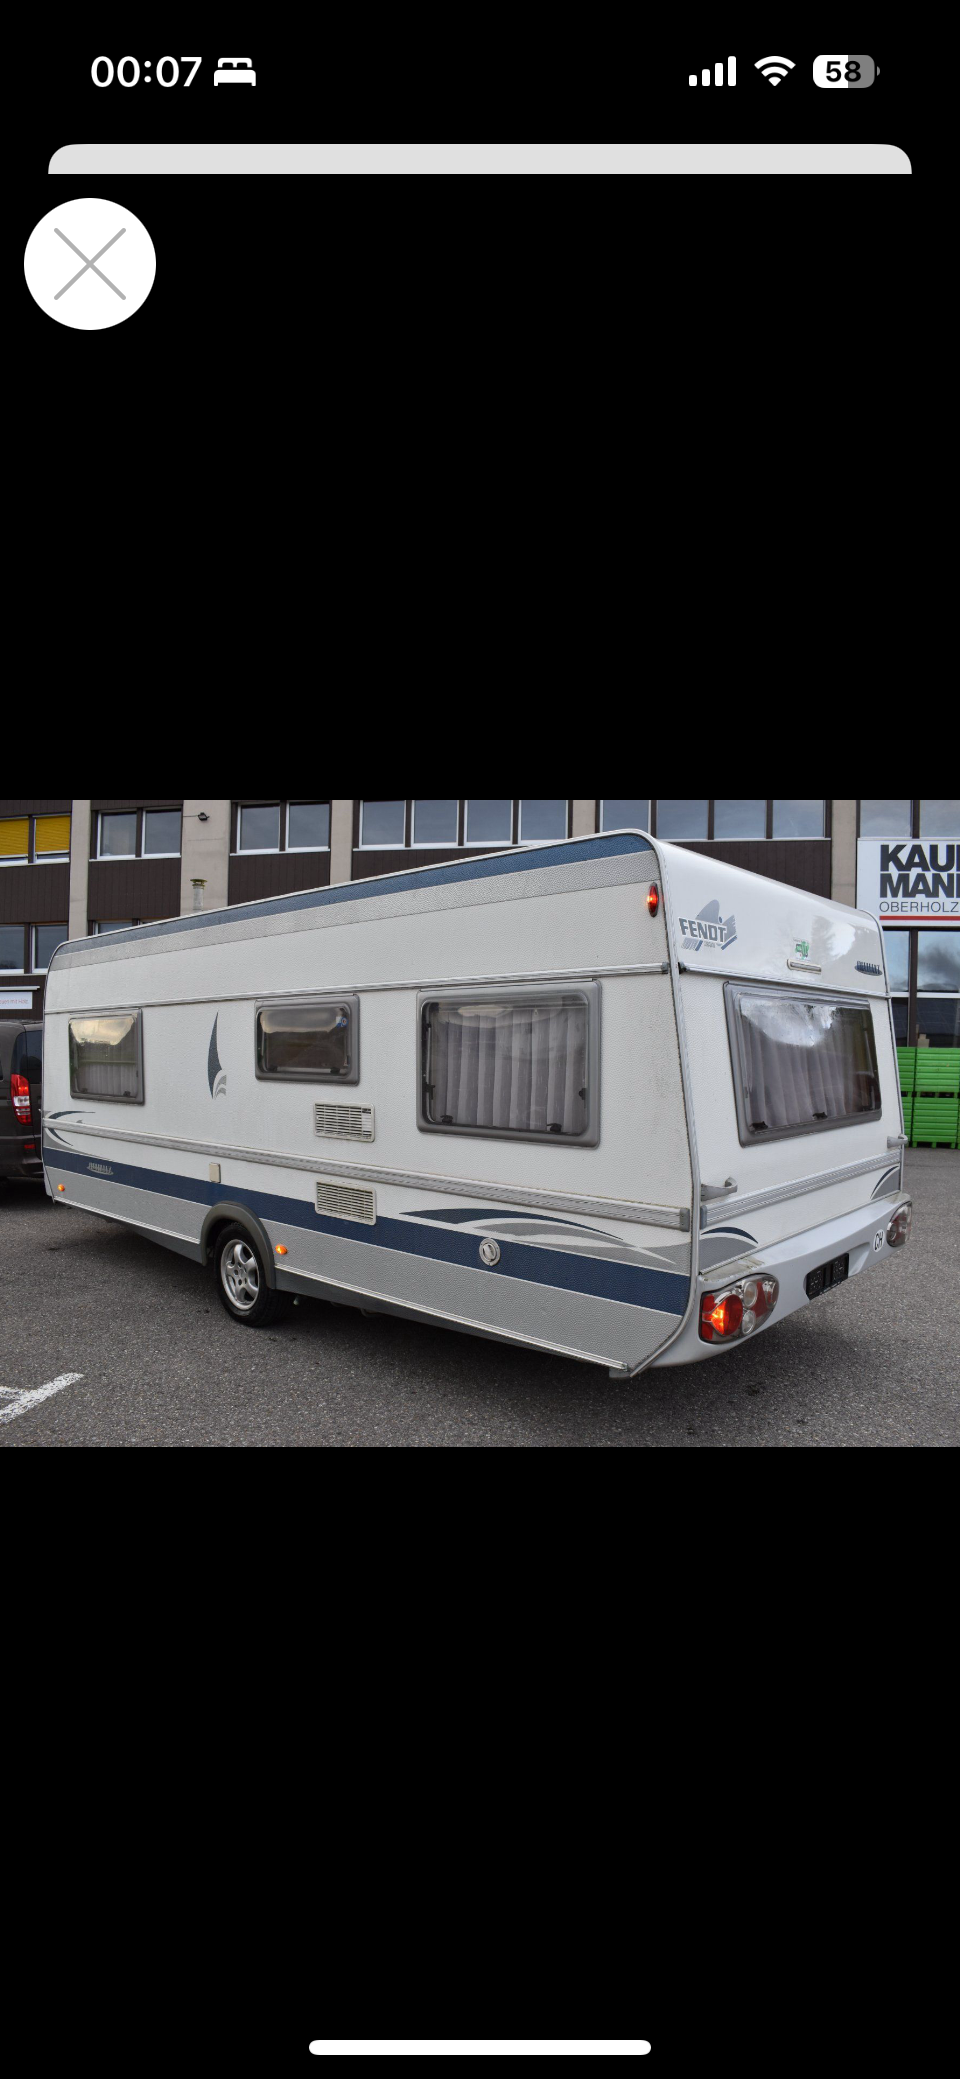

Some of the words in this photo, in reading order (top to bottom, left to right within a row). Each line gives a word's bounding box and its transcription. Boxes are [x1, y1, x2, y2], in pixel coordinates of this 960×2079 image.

[880, 844, 960, 872] KAU
[880, 872, 960, 898] MAN
[879, 901, 959, 912] OBERHOLZ
[679, 917, 726, 943] FENDT
[874, 1230, 884, 1251] CH
